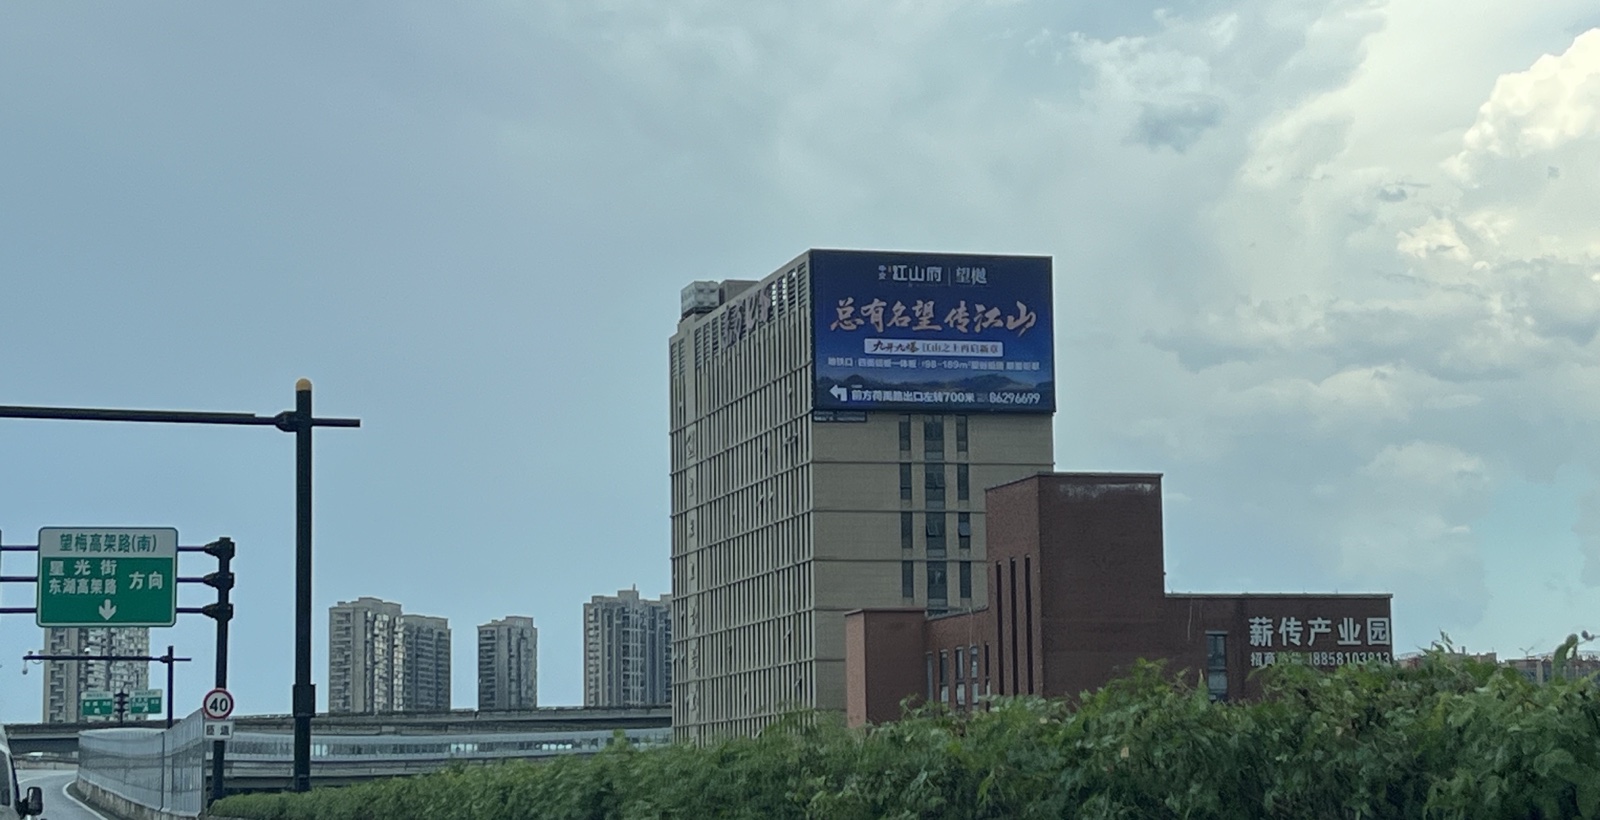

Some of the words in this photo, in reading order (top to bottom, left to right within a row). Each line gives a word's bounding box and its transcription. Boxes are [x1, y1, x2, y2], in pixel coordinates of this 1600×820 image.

[989, 392, 1041, 405] 86296699
[60, 533, 157, 553] 望梅高架路(南)
[49, 559, 117, 576] 星光街
[49, 578, 117, 595] 东湖高架路
[129, 571, 163, 590] 方向
[1248, 616, 1391, 647] 薪传产业园
[209, 697, 228, 712] 40
